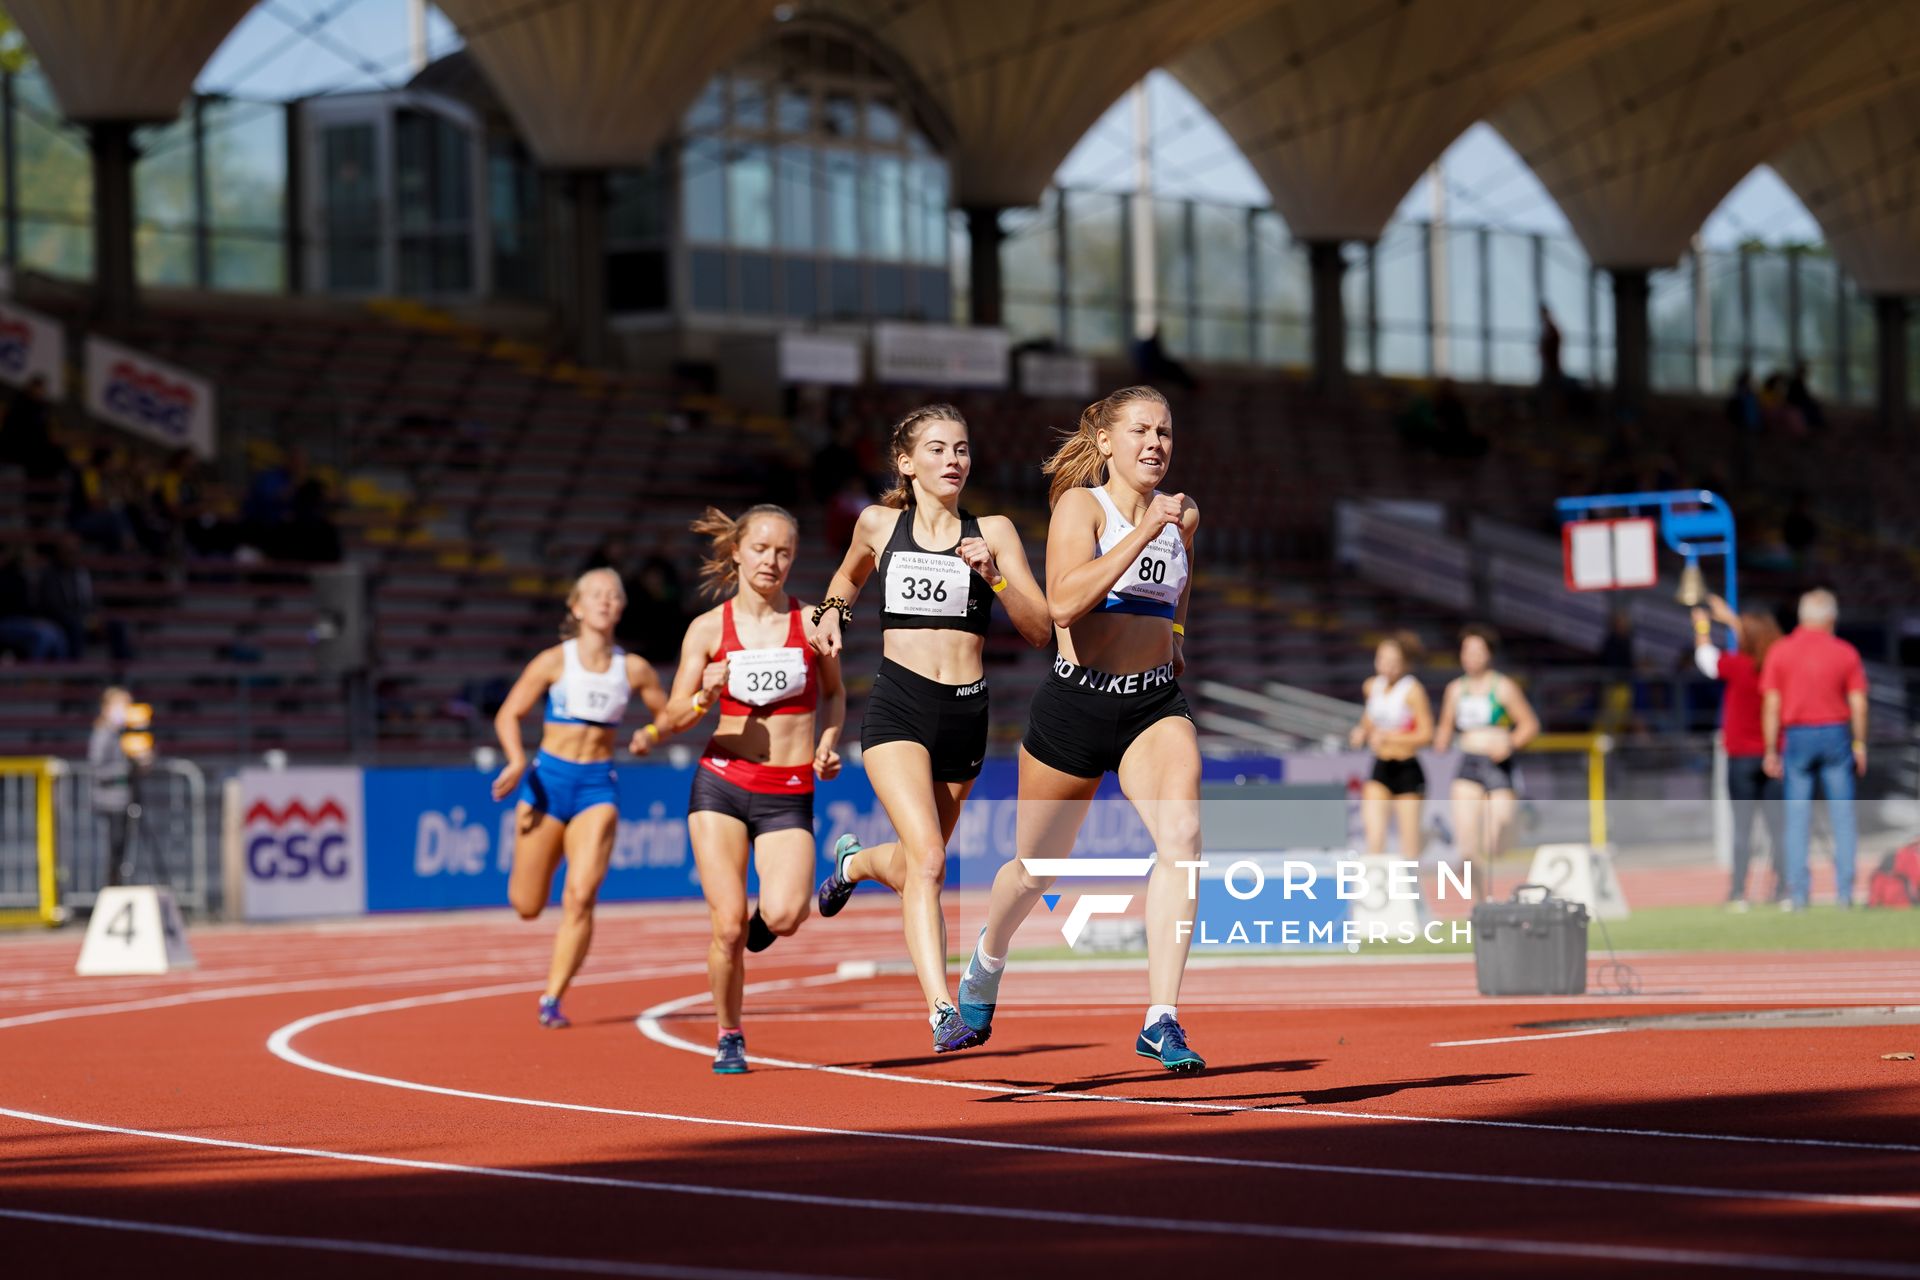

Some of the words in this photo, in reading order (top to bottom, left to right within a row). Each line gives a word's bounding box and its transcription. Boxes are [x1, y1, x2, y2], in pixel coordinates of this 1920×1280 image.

[896, 563, 961, 574] Landesmeisterschaften
[1139, 557, 1166, 584] 80
[901, 577, 947, 602] 336
[747, 670, 787, 692] 328
[1053, 653, 1074, 678] RO
[1079, 668, 1138, 694] NIKE
[1143, 661, 1174, 690] PRO
[956, 683, 980, 697] NIKE
[415, 806, 489, 877] Die
[247, 834, 350, 879] GSG
[106, 899, 136, 946] 4
